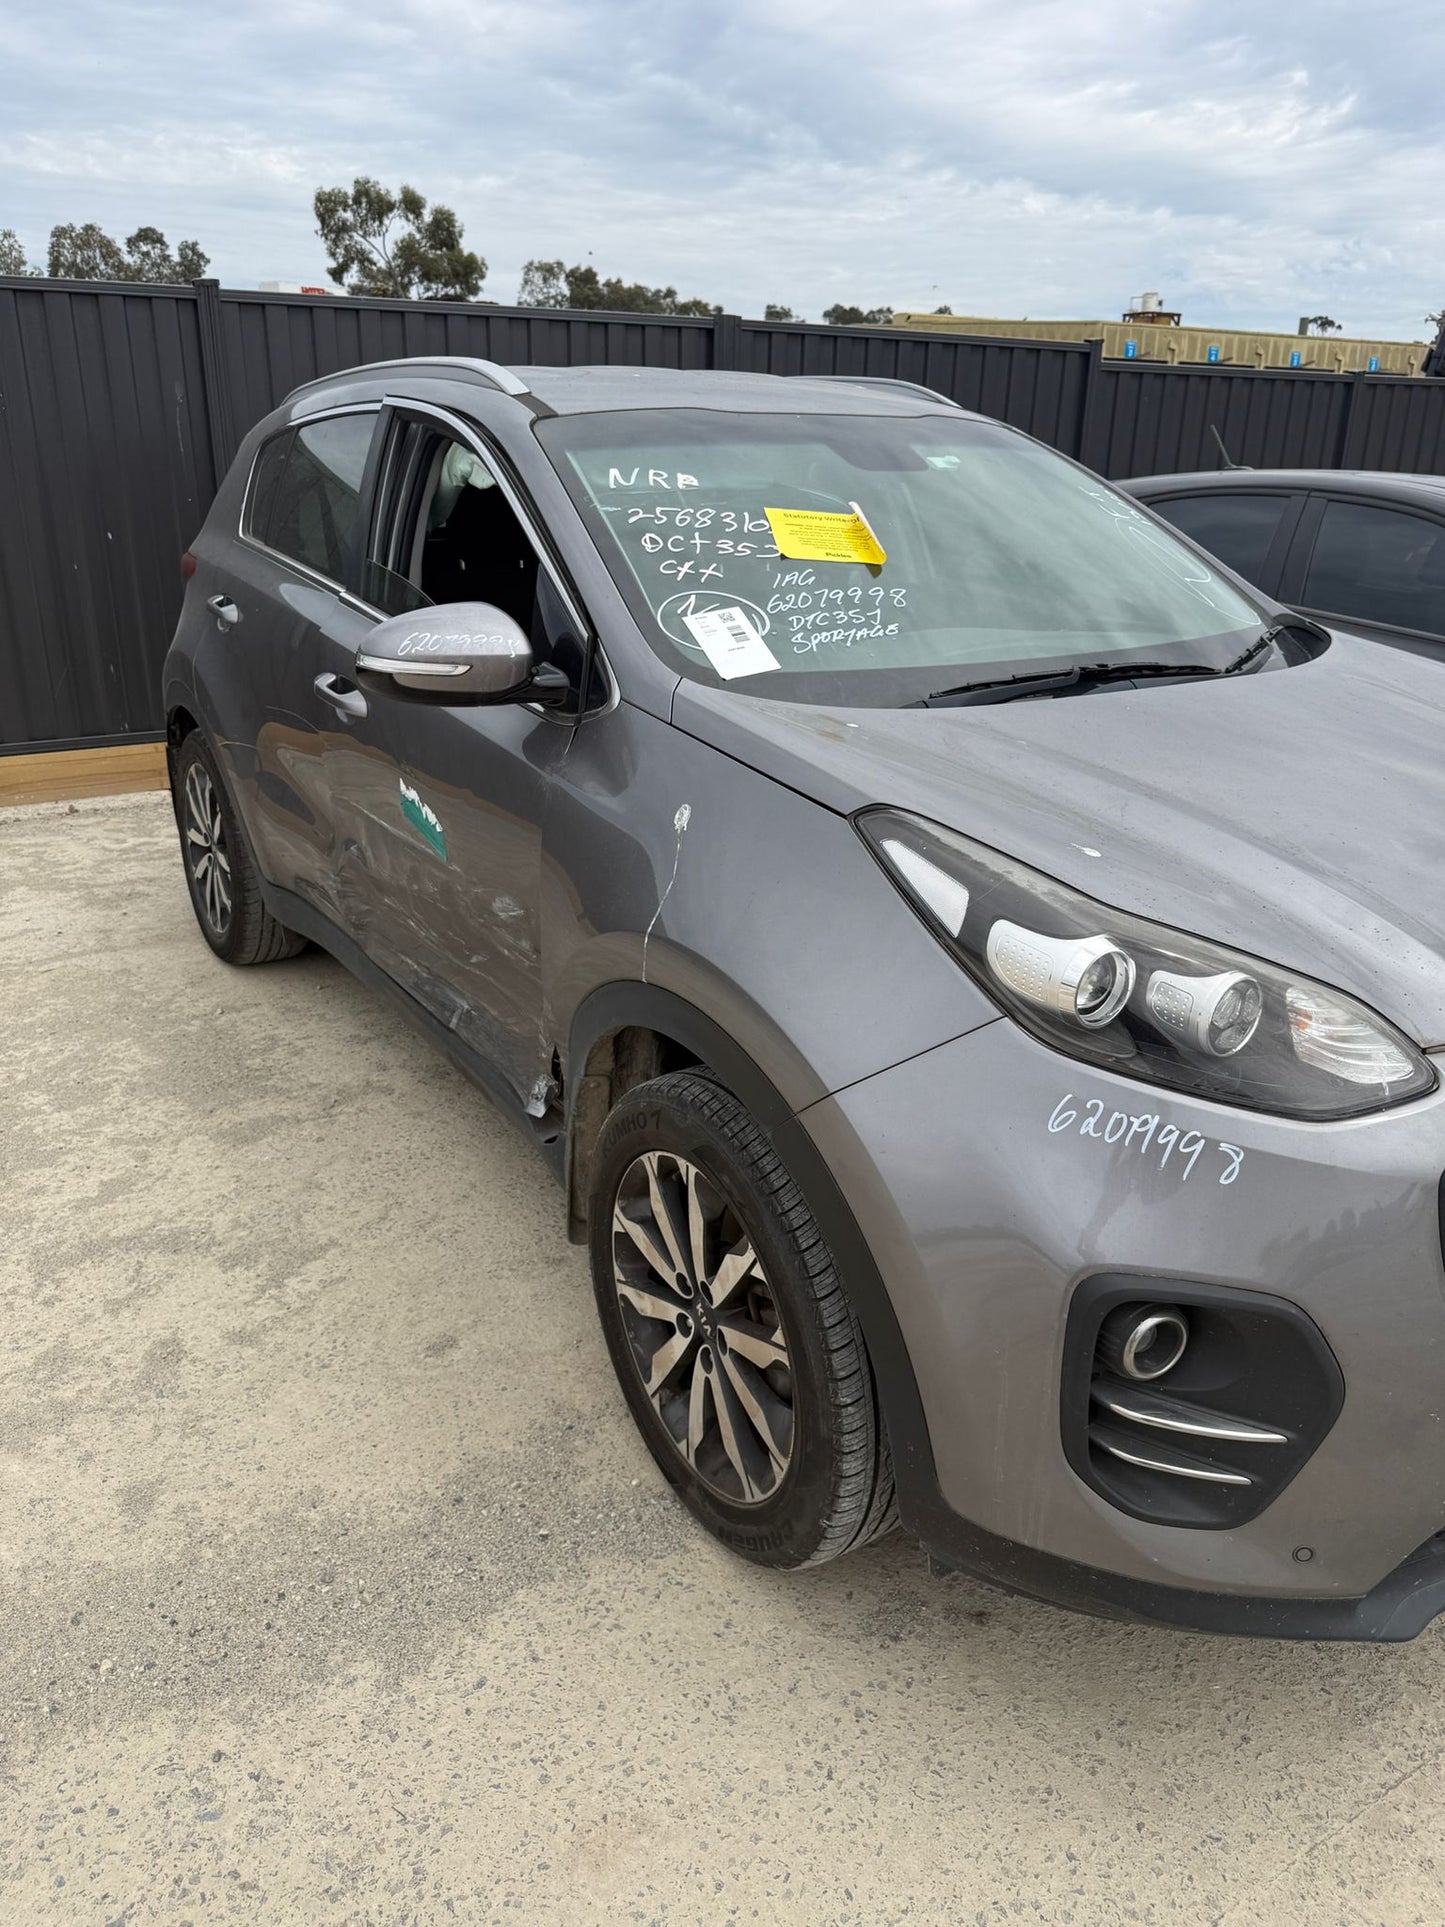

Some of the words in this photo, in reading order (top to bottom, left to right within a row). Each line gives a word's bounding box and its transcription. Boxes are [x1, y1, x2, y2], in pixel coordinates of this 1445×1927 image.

[783, 512, 822, 521] Statutory
[767, 587, 907, 614] 62079998
[600, 1110, 648, 1159] KUMHO
[1047, 1094, 1245, 1185] 62079998
